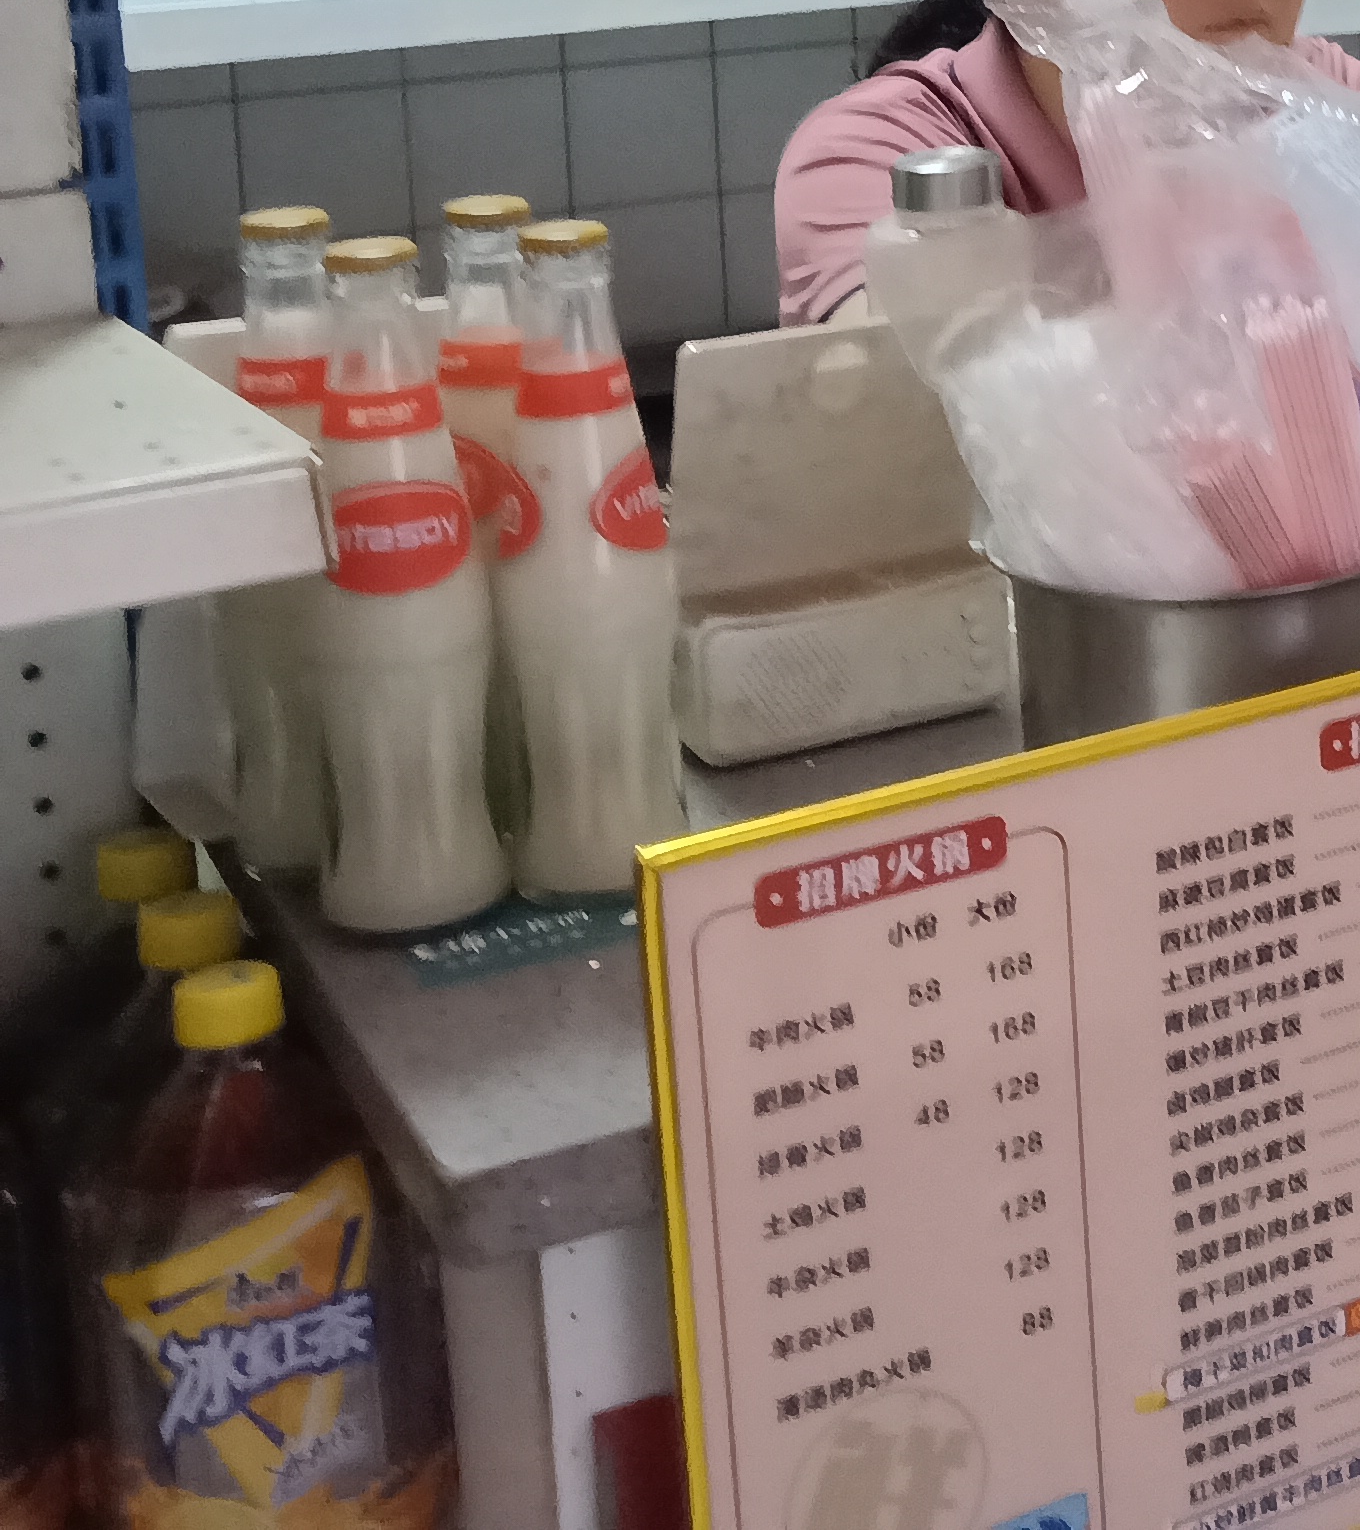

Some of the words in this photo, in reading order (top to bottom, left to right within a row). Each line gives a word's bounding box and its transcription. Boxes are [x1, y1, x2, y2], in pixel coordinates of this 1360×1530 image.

[796, 828, 971, 914] 招牌火锅
[908, 978, 941, 1007] 58
[987, 951, 1032, 980] 168
[912, 1040, 945, 1068] 58
[990, 1011, 1035, 1041] 168
[914, 1099, 949, 1127] 48
[994, 1072, 1040, 1101] 128
[995, 1130, 1043, 1160] 128
[1001, 1189, 1046, 1220] 128
[1004, 1247, 1050, 1278] 128
[1021, 1305, 1054, 1336] 88
[158, 1290, 374, 1447] 冰红茶
